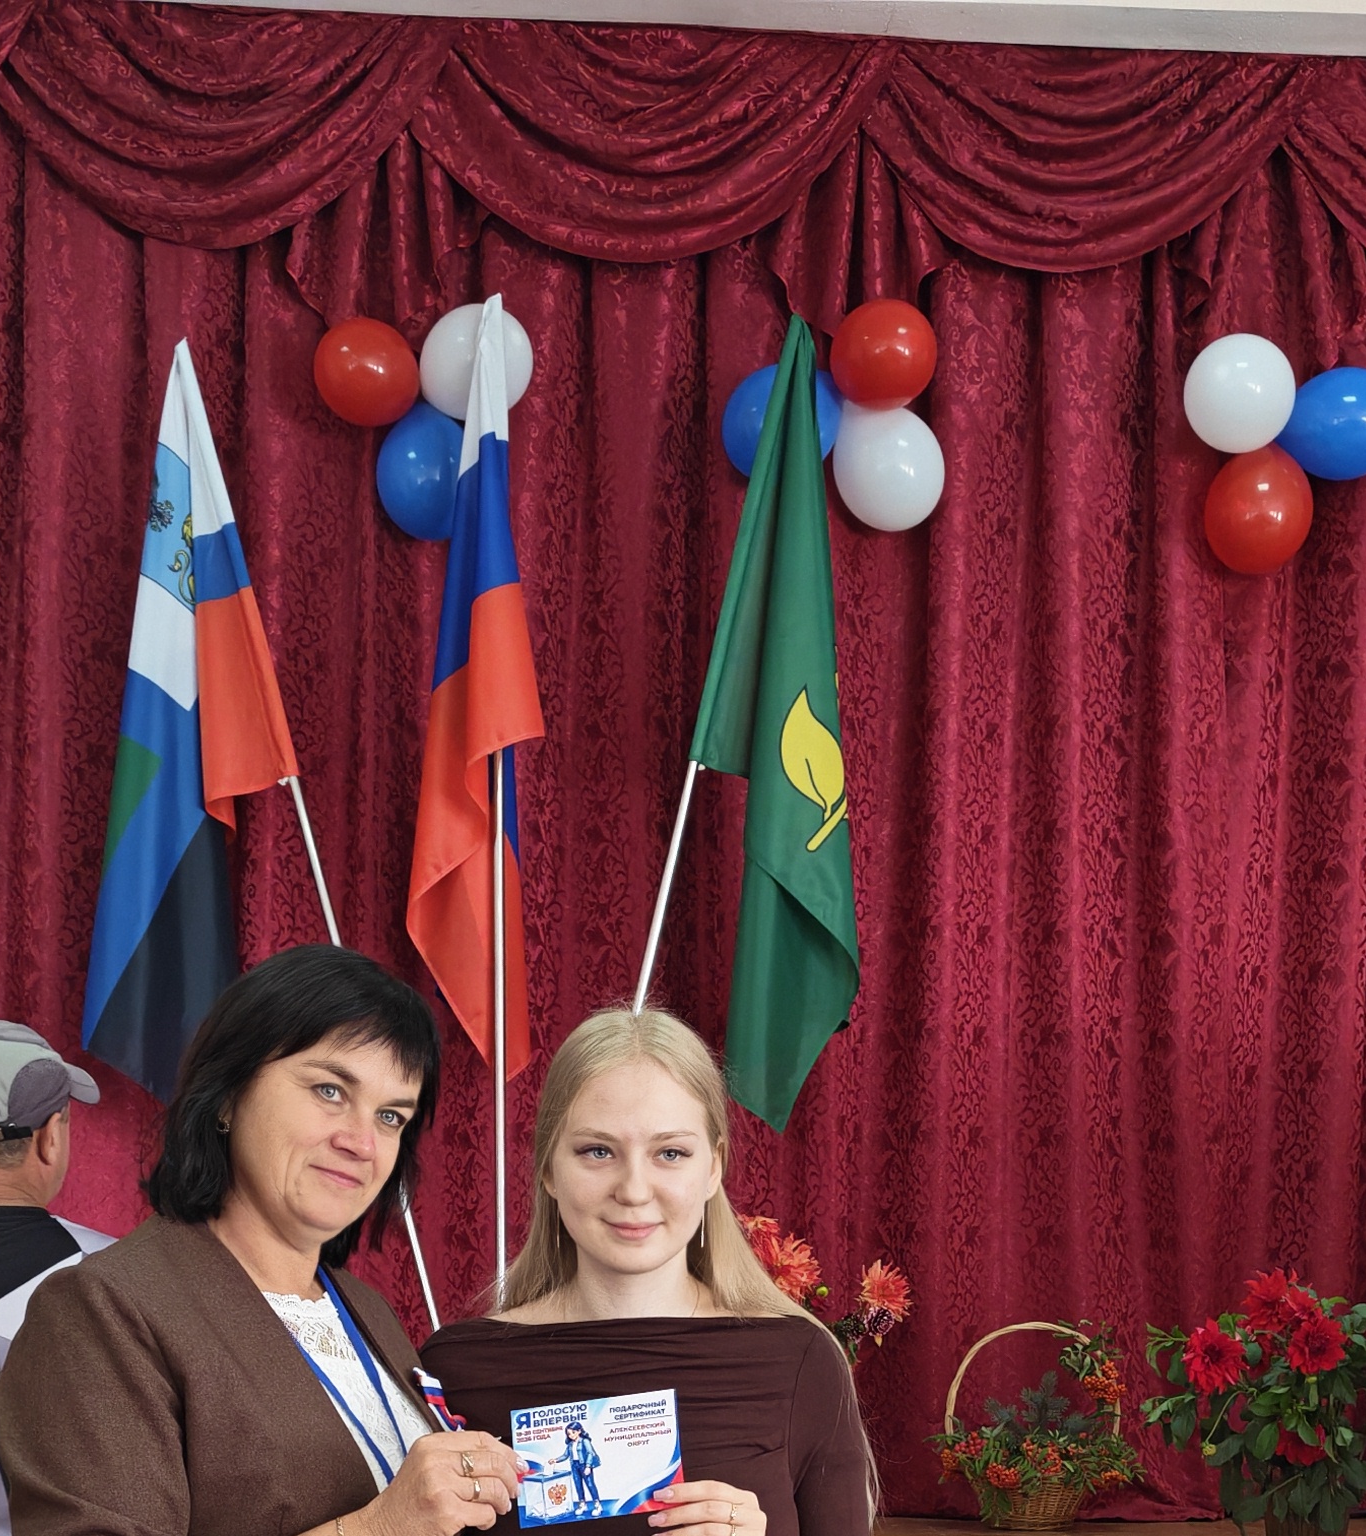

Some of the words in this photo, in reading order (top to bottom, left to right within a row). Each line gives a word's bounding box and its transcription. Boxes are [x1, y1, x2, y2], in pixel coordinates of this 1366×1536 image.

[609, 1399, 667, 1413] ПОДАРОЧНЫЙ
[515, 1411, 531, 1430] Я
[533, 1403, 587, 1418] ГОЛОСУЮ
[533, 1412, 588, 1428] ВПЕРВЫЕ
[614, 1408, 666, 1421] СЕРТИФИКАТ
[609, 1421, 666, 1434] АЛЕКСЕЕВСКИЙ
[533, 1434, 551, 1442] ГОДА
[604, 1428, 672, 1443] МУНИЦИПАЛЬНЫЙ
[627, 1439, 650, 1447] ОКРУГ
